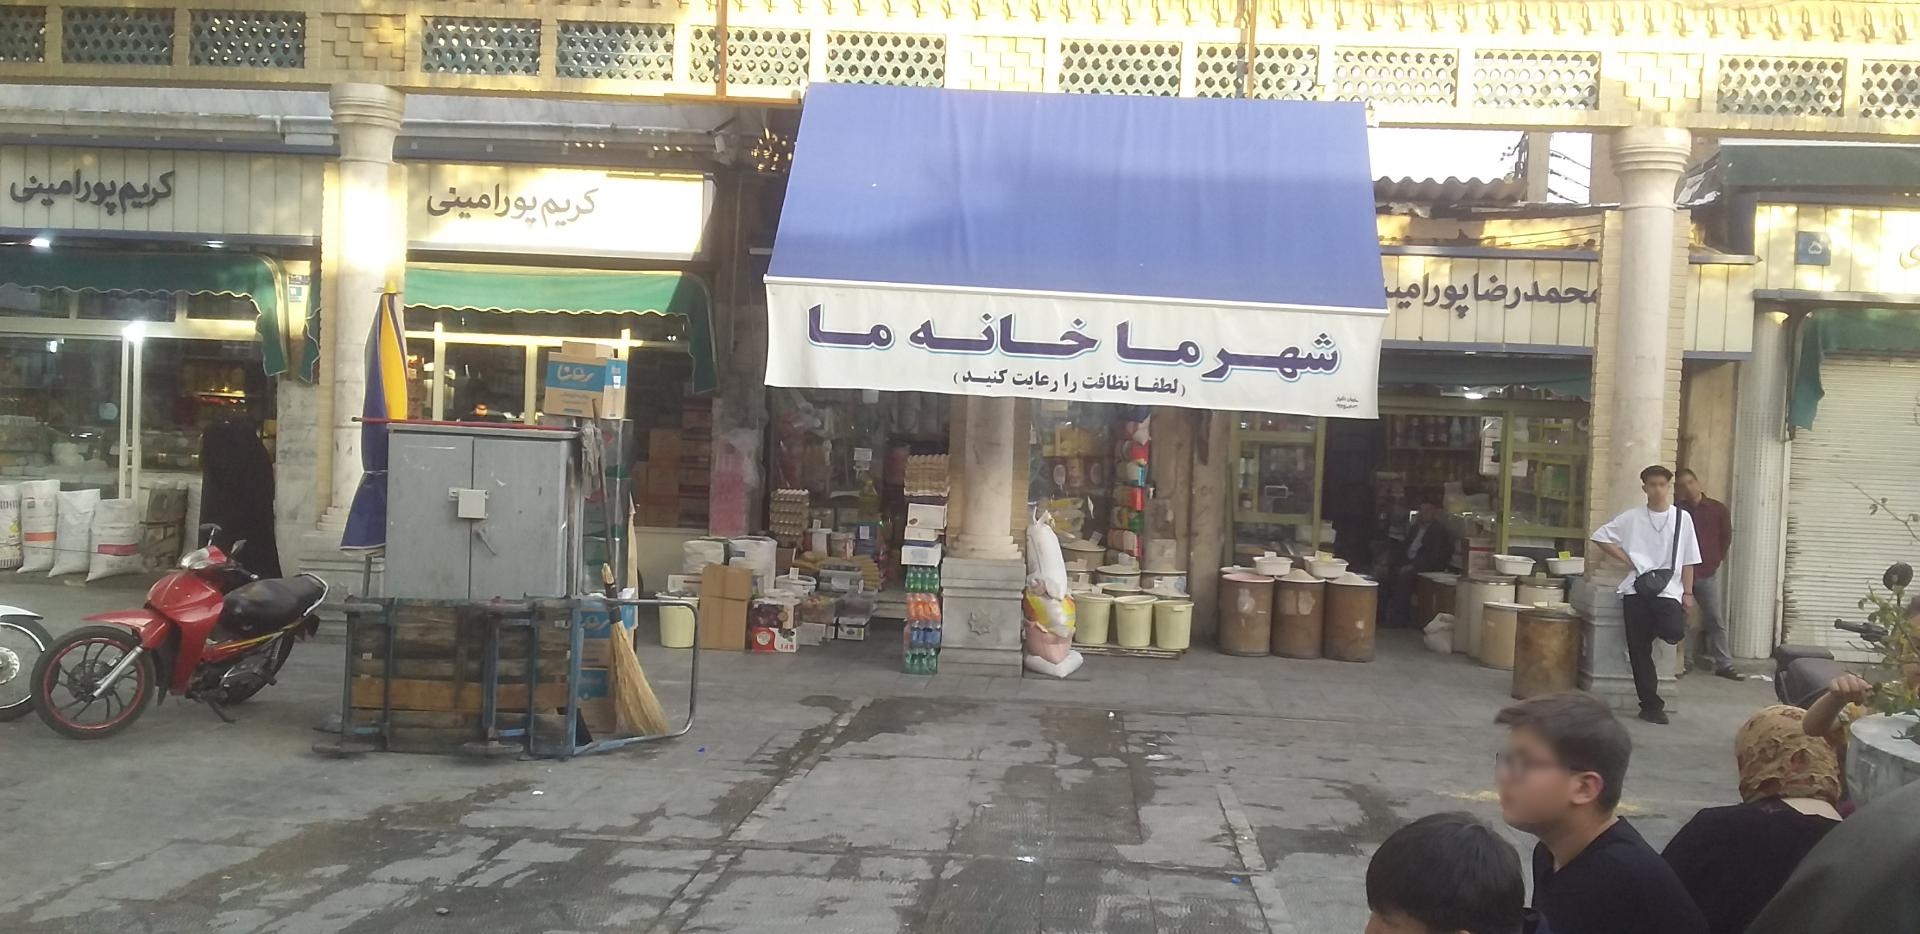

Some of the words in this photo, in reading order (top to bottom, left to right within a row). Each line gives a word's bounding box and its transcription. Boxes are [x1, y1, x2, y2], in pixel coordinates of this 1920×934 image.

[118, 170, 176, 215] کریم
[540, 187, 600, 227] کریم
[1807, 240, 1823, 255] ۵
[807, 303, 896, 351] ما
[908, 312, 1100, 360] خانه
[1115, 319, 1201, 368] ما
[1200, 332, 1342, 382] شهر
[1011, 370, 1059, 392] رعایت
[1063, 372, 1078, 393] را
[1081, 372, 1130, 391] نظافت
